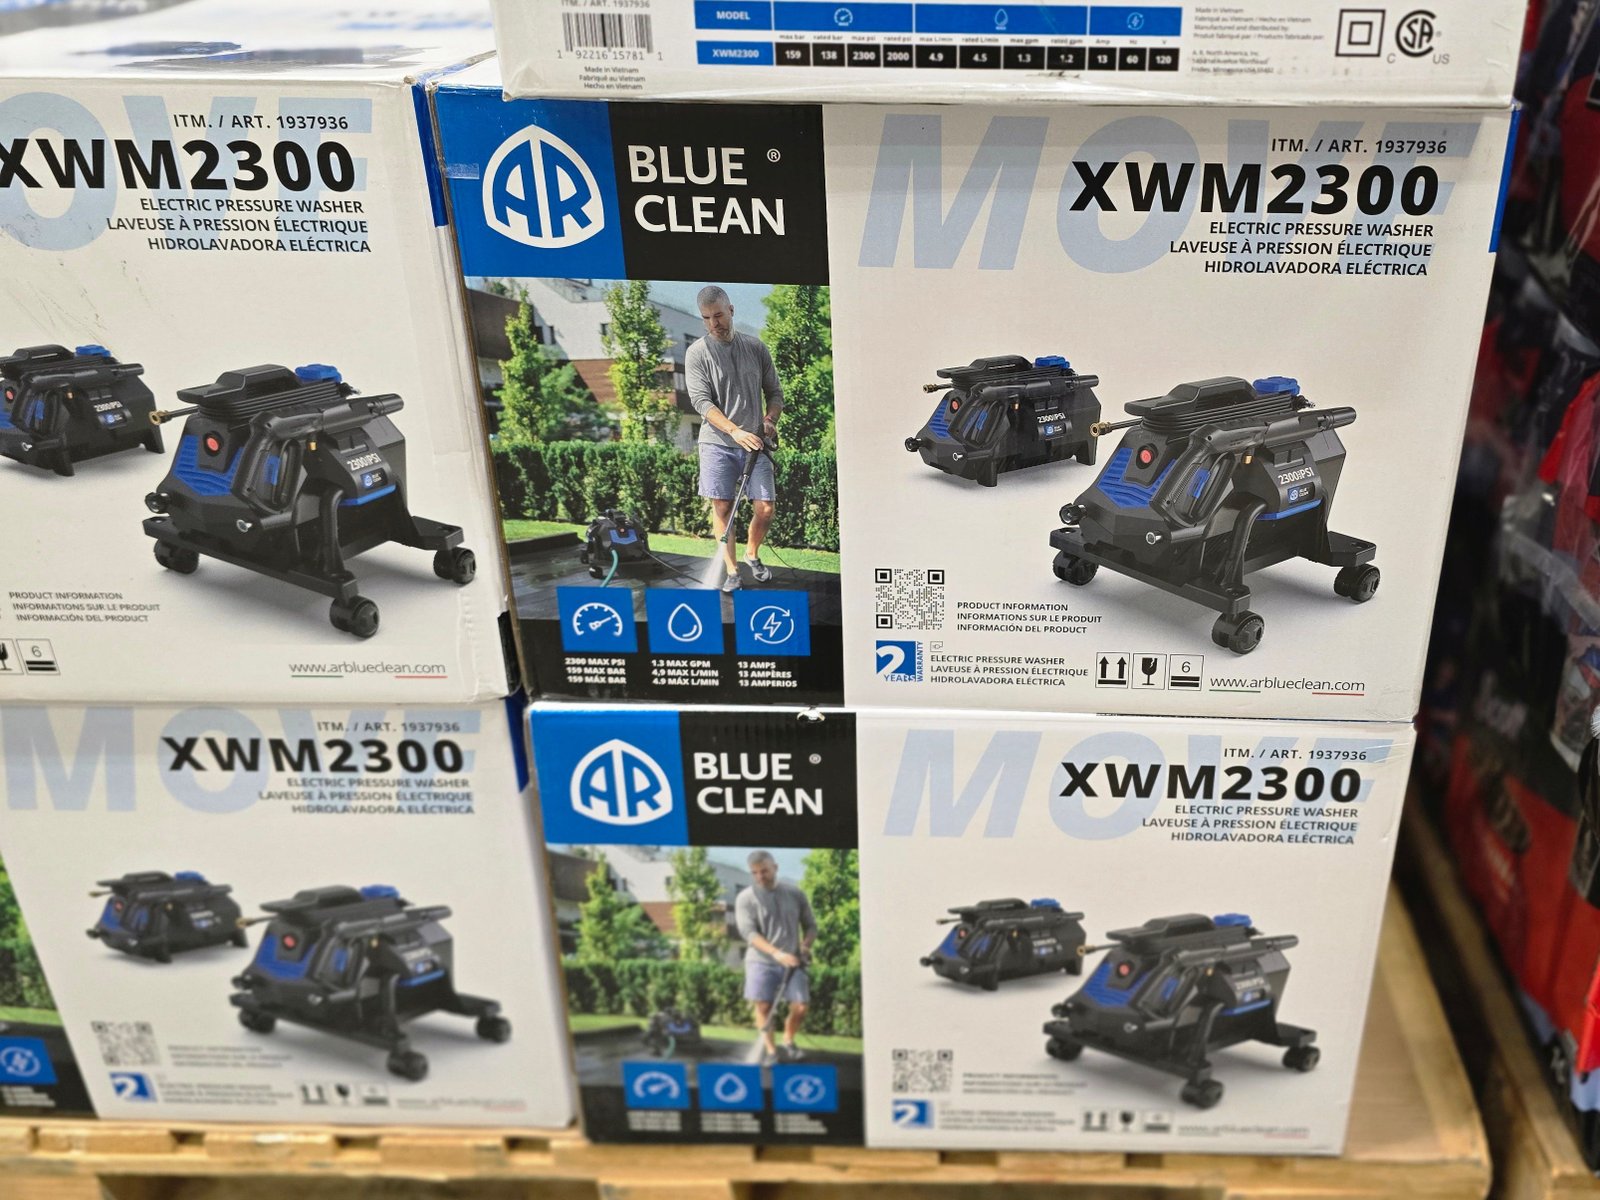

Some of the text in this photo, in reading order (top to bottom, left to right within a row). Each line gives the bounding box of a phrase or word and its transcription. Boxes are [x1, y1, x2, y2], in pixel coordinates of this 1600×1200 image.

[717, 11, 750, 20] MODEL
[557, 49, 663, 61] 1 92216 15781 1
[713, 49, 1171, 64] XWM2300 159 138 2300 2000 4.9 4.5 1.3 1.2 13 60 120
[1387, 54, 1395, 63] C
[1432, 54, 1449, 64] US
[174, 114, 348, 129] ITM. ART. 1937936
[1272, 138, 1447, 154] ITM. ART. 1937936
[0, 138, 355, 192] XWM2300
[628, 145, 747, 185] BLUE
[858, 114, 1480, 274] MOVE
[1069, 161, 1438, 216] XWM2300
[140, 198, 364, 213] ELECTRIC PRESSURE WASHER
[635, 195, 785, 235] CLEAN
[106, 215, 368, 235] LAVEUSE À PRESSION ÉLECTRIQUE
[1210, 222, 1433, 237] ELECTRIC PRESSURE WASHER
[148, 236, 371, 252] HIDROLAVADORA ELÉCTRICA
[1170, 238, 1432, 259] LAVEUSE À PRESSION ÉLECTRIQUE
[1205, 260, 1427, 276] HIDROLAVADORA ELÉCTRICA
[1003, 603, 1068, 611] INFORMATION
[957, 613, 1027, 621] INFORMATIONS
[1062, 615, 1102, 623] PRODUIT
[957, 624, 1022, 632] INFORMACIÓN
[31, 645, 42, 658] 6
[289, 661, 446, 673] www.arblueclean.com
[876, 645, 905, 676] 2
[916, 641, 924, 682] WARRANTY
[931, 655, 1065, 665] ELECTRIC PRESSURE WASHER
[1181, 661, 1191, 673] 6
[585, 675, 606, 683] MÁX
[750, 670, 792, 678] AMPÈRES
[884, 674, 916, 682] YEARS
[1032, 667, 1088, 677] ÉLECTRIQUE
[668, 677, 689, 685] MÁX
[931, 676, 1065, 686] HIDROLAVADORA ELÉCTRICA
[1209, 677, 1365, 693] www.arblueclean.com
[317, 722, 460, 732] ITM. ART. 1937936
[0, 705, 481, 814] MOVE
[161, 737, 463, 773] XWM2300
[1224, 748, 1366, 760] ITM. ART. 1937936
[694, 752, 793, 780] BLUE
[287, 778, 468, 788] ELECTRIC PRESSURE WASHER
[883, 729, 1393, 841] MOVE
[1059, 762, 1361, 803] XWM2300
[258, 791, 472, 803] LAVEUSE À PRESSION ÉLECTRIQUE
[697, 786, 823, 815] CLEAN
[292, 804, 474, 814] HIDROLAVADORA ELÉCTRICA
[1175, 805, 1358, 817] ELECTRIC PRESSURE WASHER
[1142, 817, 1357, 832] LAVEUSE À PRESSION ÉLECTRIQUE
[1171, 832, 1354, 844] HIDROLAVADORA ELÉCTRICA
